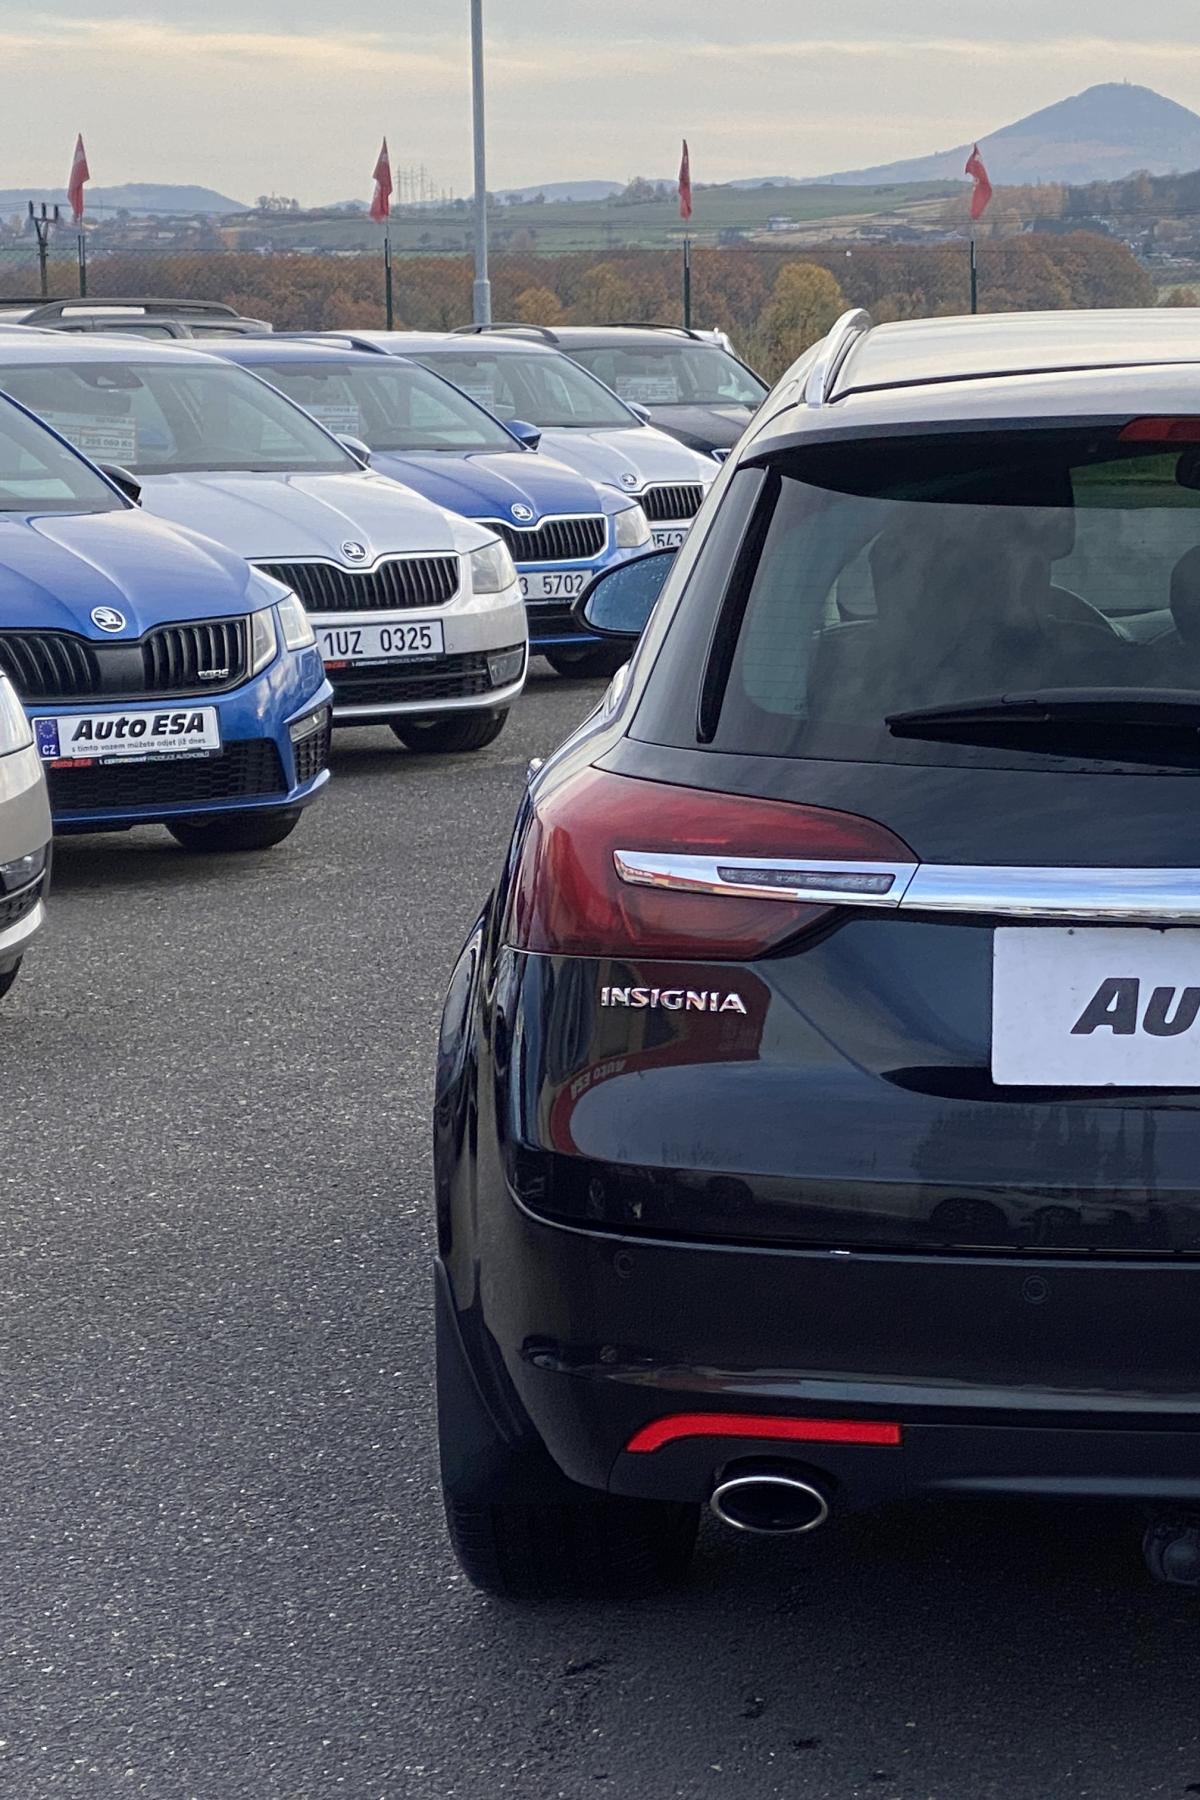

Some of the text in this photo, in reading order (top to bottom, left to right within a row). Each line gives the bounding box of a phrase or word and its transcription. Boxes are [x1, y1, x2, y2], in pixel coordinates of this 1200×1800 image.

[543, 574, 584, 595] 5702
[323, 626, 432, 656] 1UZ 0325
[71, 712, 205, 742] Auto ESA
[42, 745, 56, 756] CZ
[601, 986, 748, 1015] INSIGNIA
